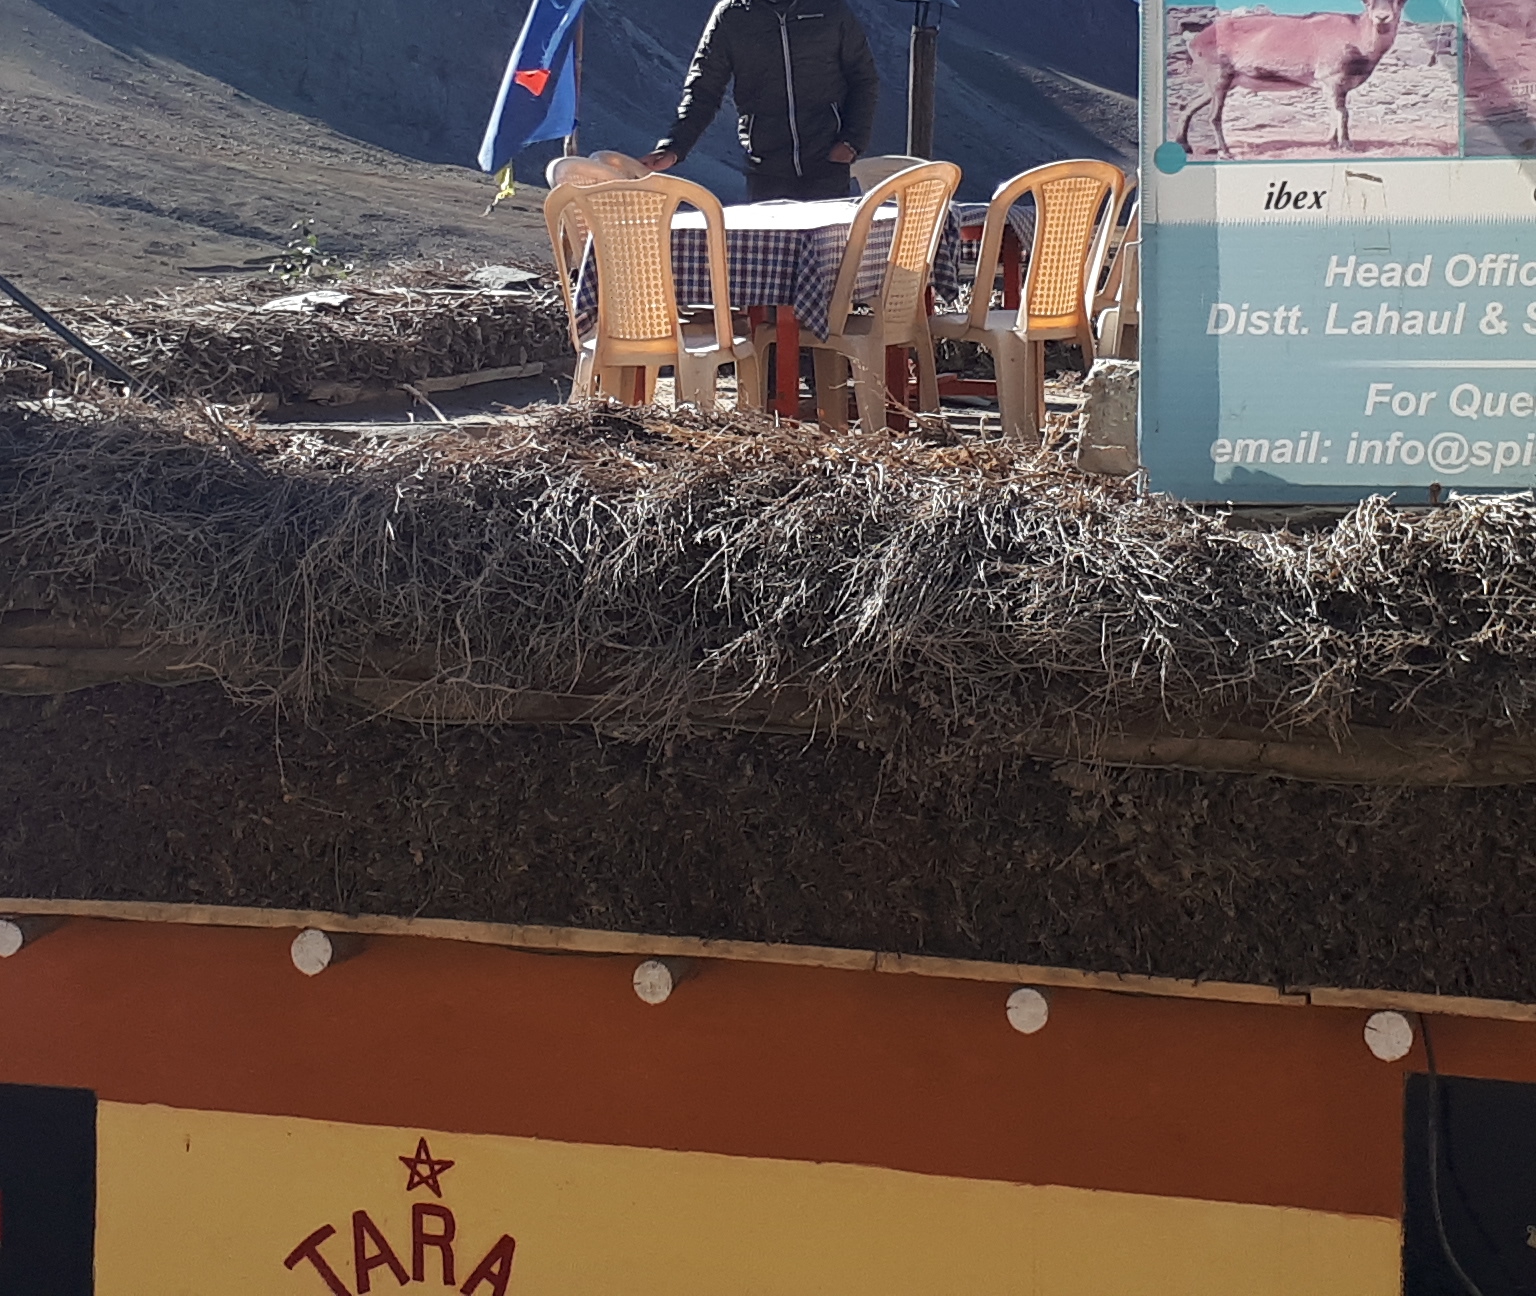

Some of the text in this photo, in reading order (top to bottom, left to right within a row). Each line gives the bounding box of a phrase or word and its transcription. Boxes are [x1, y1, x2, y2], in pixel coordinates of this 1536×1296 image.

[1263, 180, 1327, 212] ibex
[1325, 254, 1431, 288] Head
[1206, 303, 1309, 336] Distt.
[1324, 301, 1466, 336] Lahaul
[1478, 303, 1510, 336] &
[1364, 382, 1436, 418] For
[1209, 432, 1330, 464] email:
[284, 1202, 516, 1296] TARA
